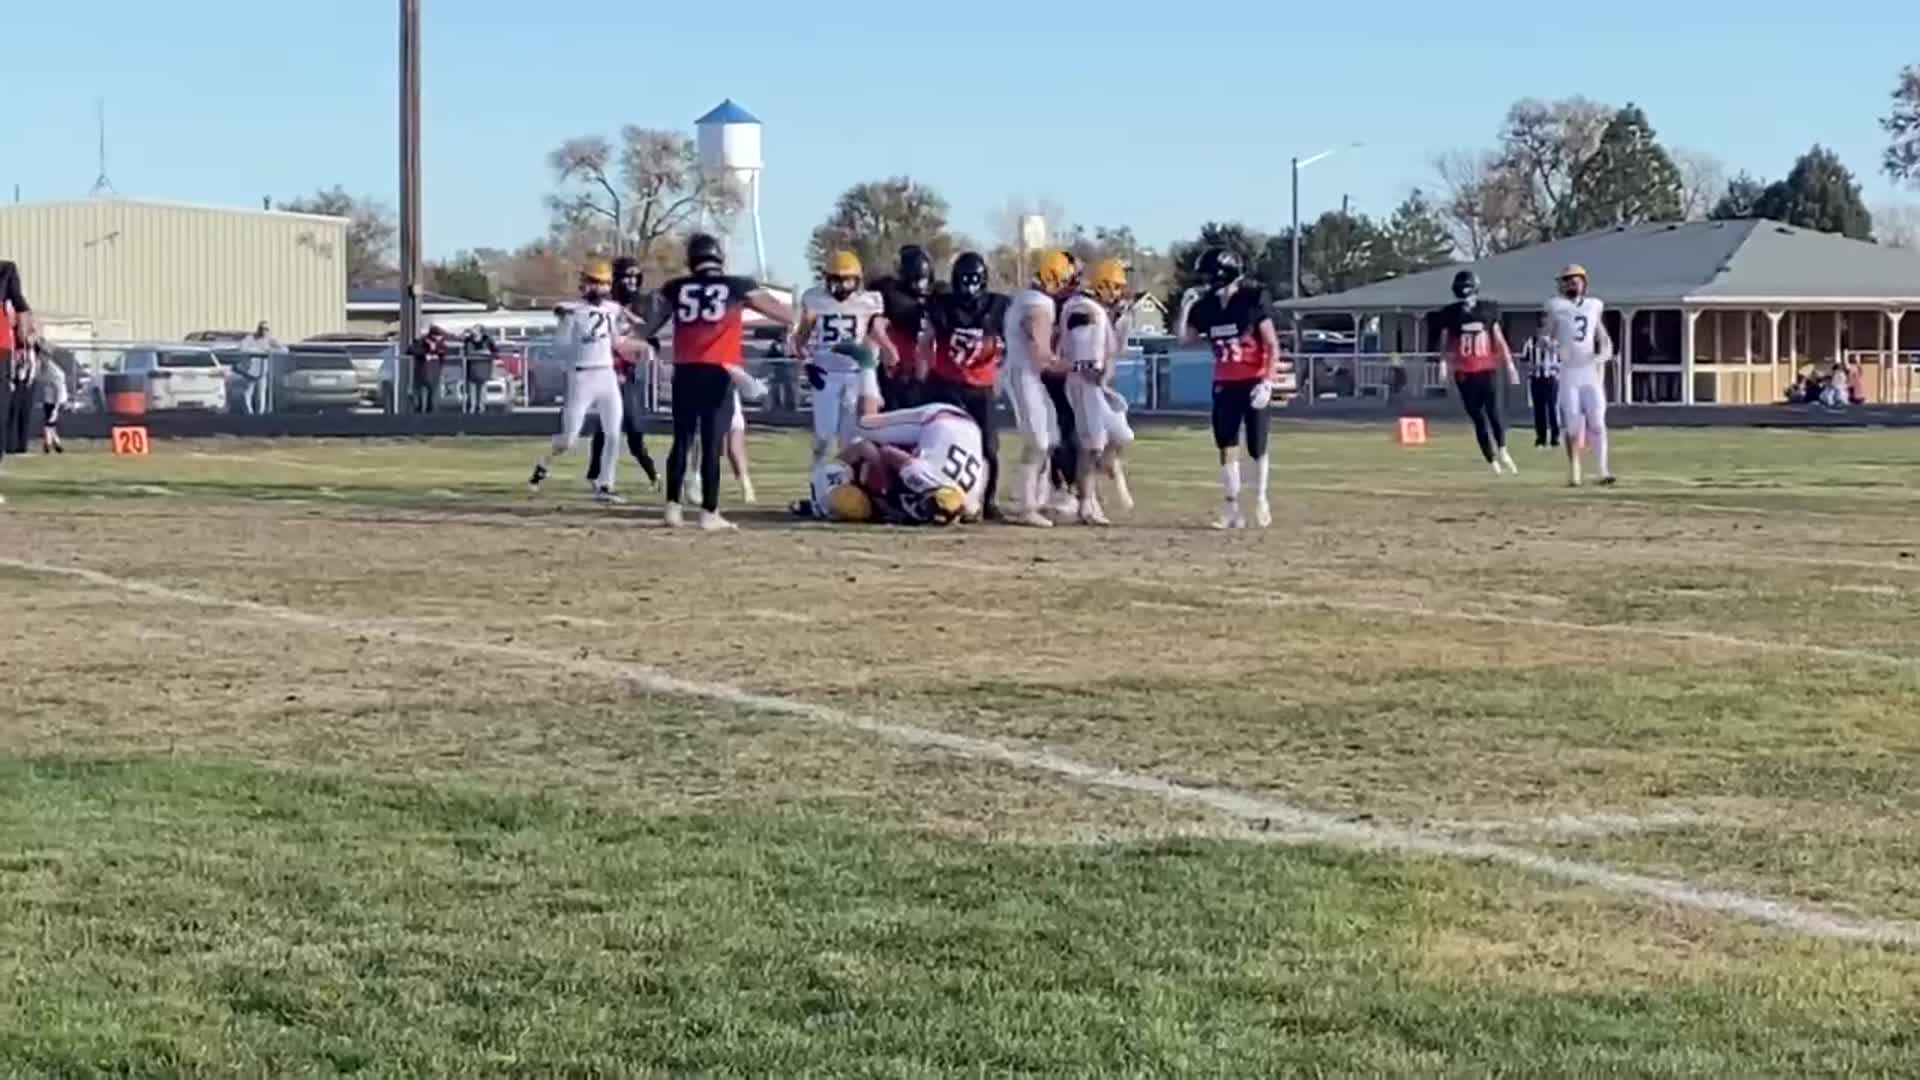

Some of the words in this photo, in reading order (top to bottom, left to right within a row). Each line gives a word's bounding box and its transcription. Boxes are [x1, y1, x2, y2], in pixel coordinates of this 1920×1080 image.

[678, 284, 730, 322] 53
[823, 314, 857, 341] 53
[1572, 315, 1588, 342] 3
[119, 431, 143, 453] 20
[941, 443, 980, 494] 55
